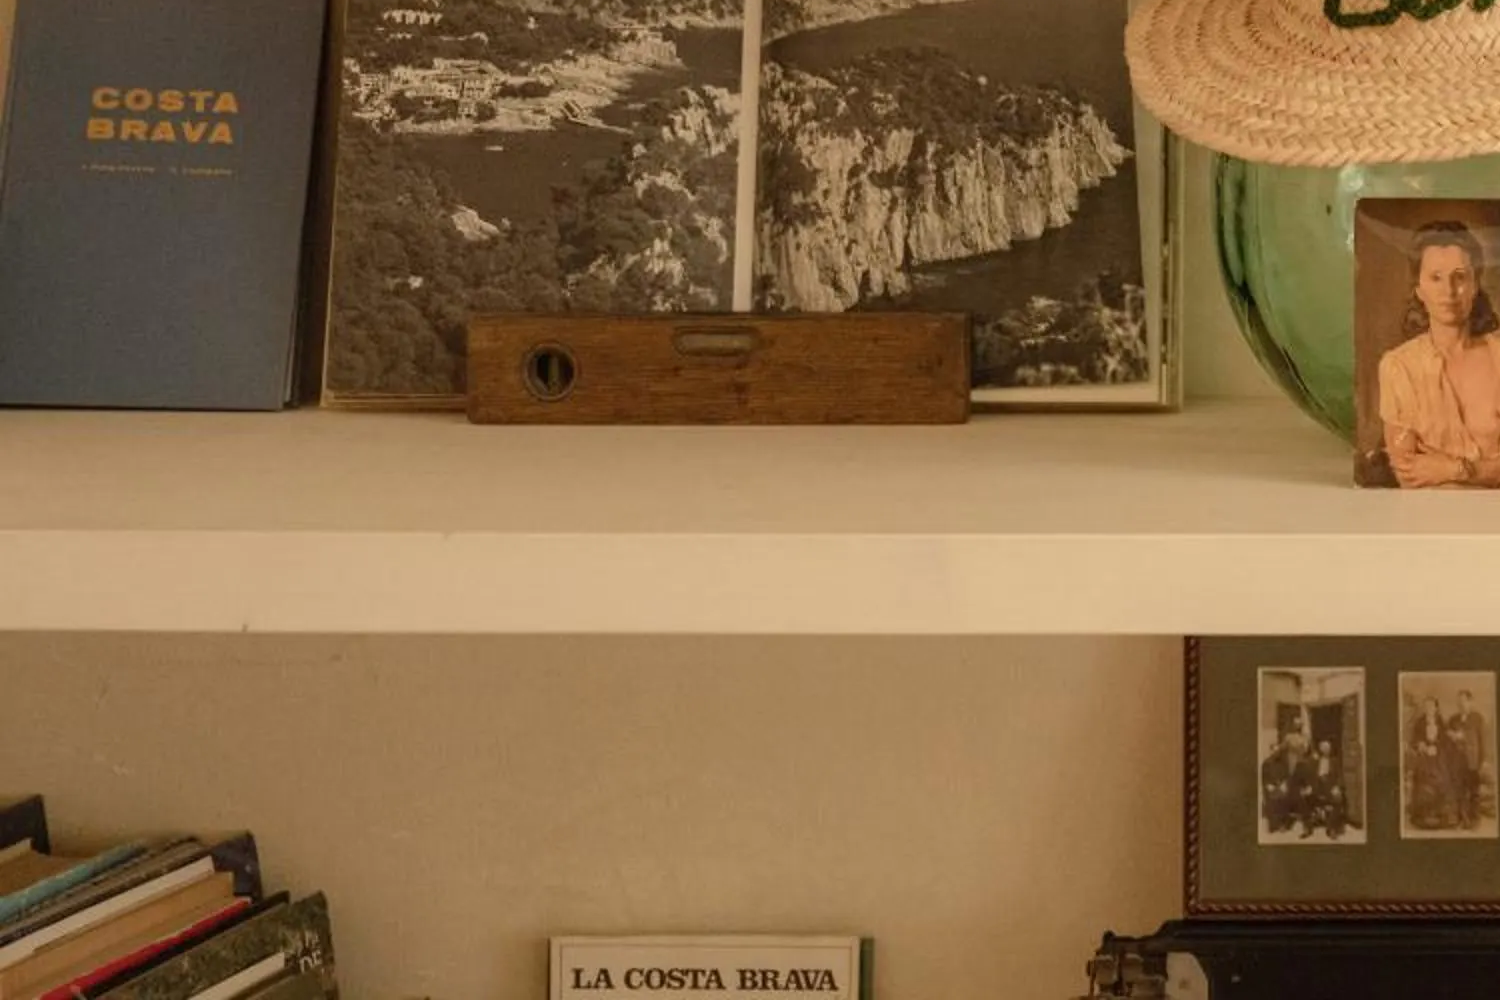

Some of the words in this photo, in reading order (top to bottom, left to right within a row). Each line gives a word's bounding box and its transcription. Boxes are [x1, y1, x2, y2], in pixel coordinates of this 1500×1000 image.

[93, 87, 238, 113] COSTA
[87, 118, 233, 144] BRAVA
[571, 968, 615, 990] LA
[624, 968, 726, 990] COSTA
[736, 969, 839, 991] BRAVA
